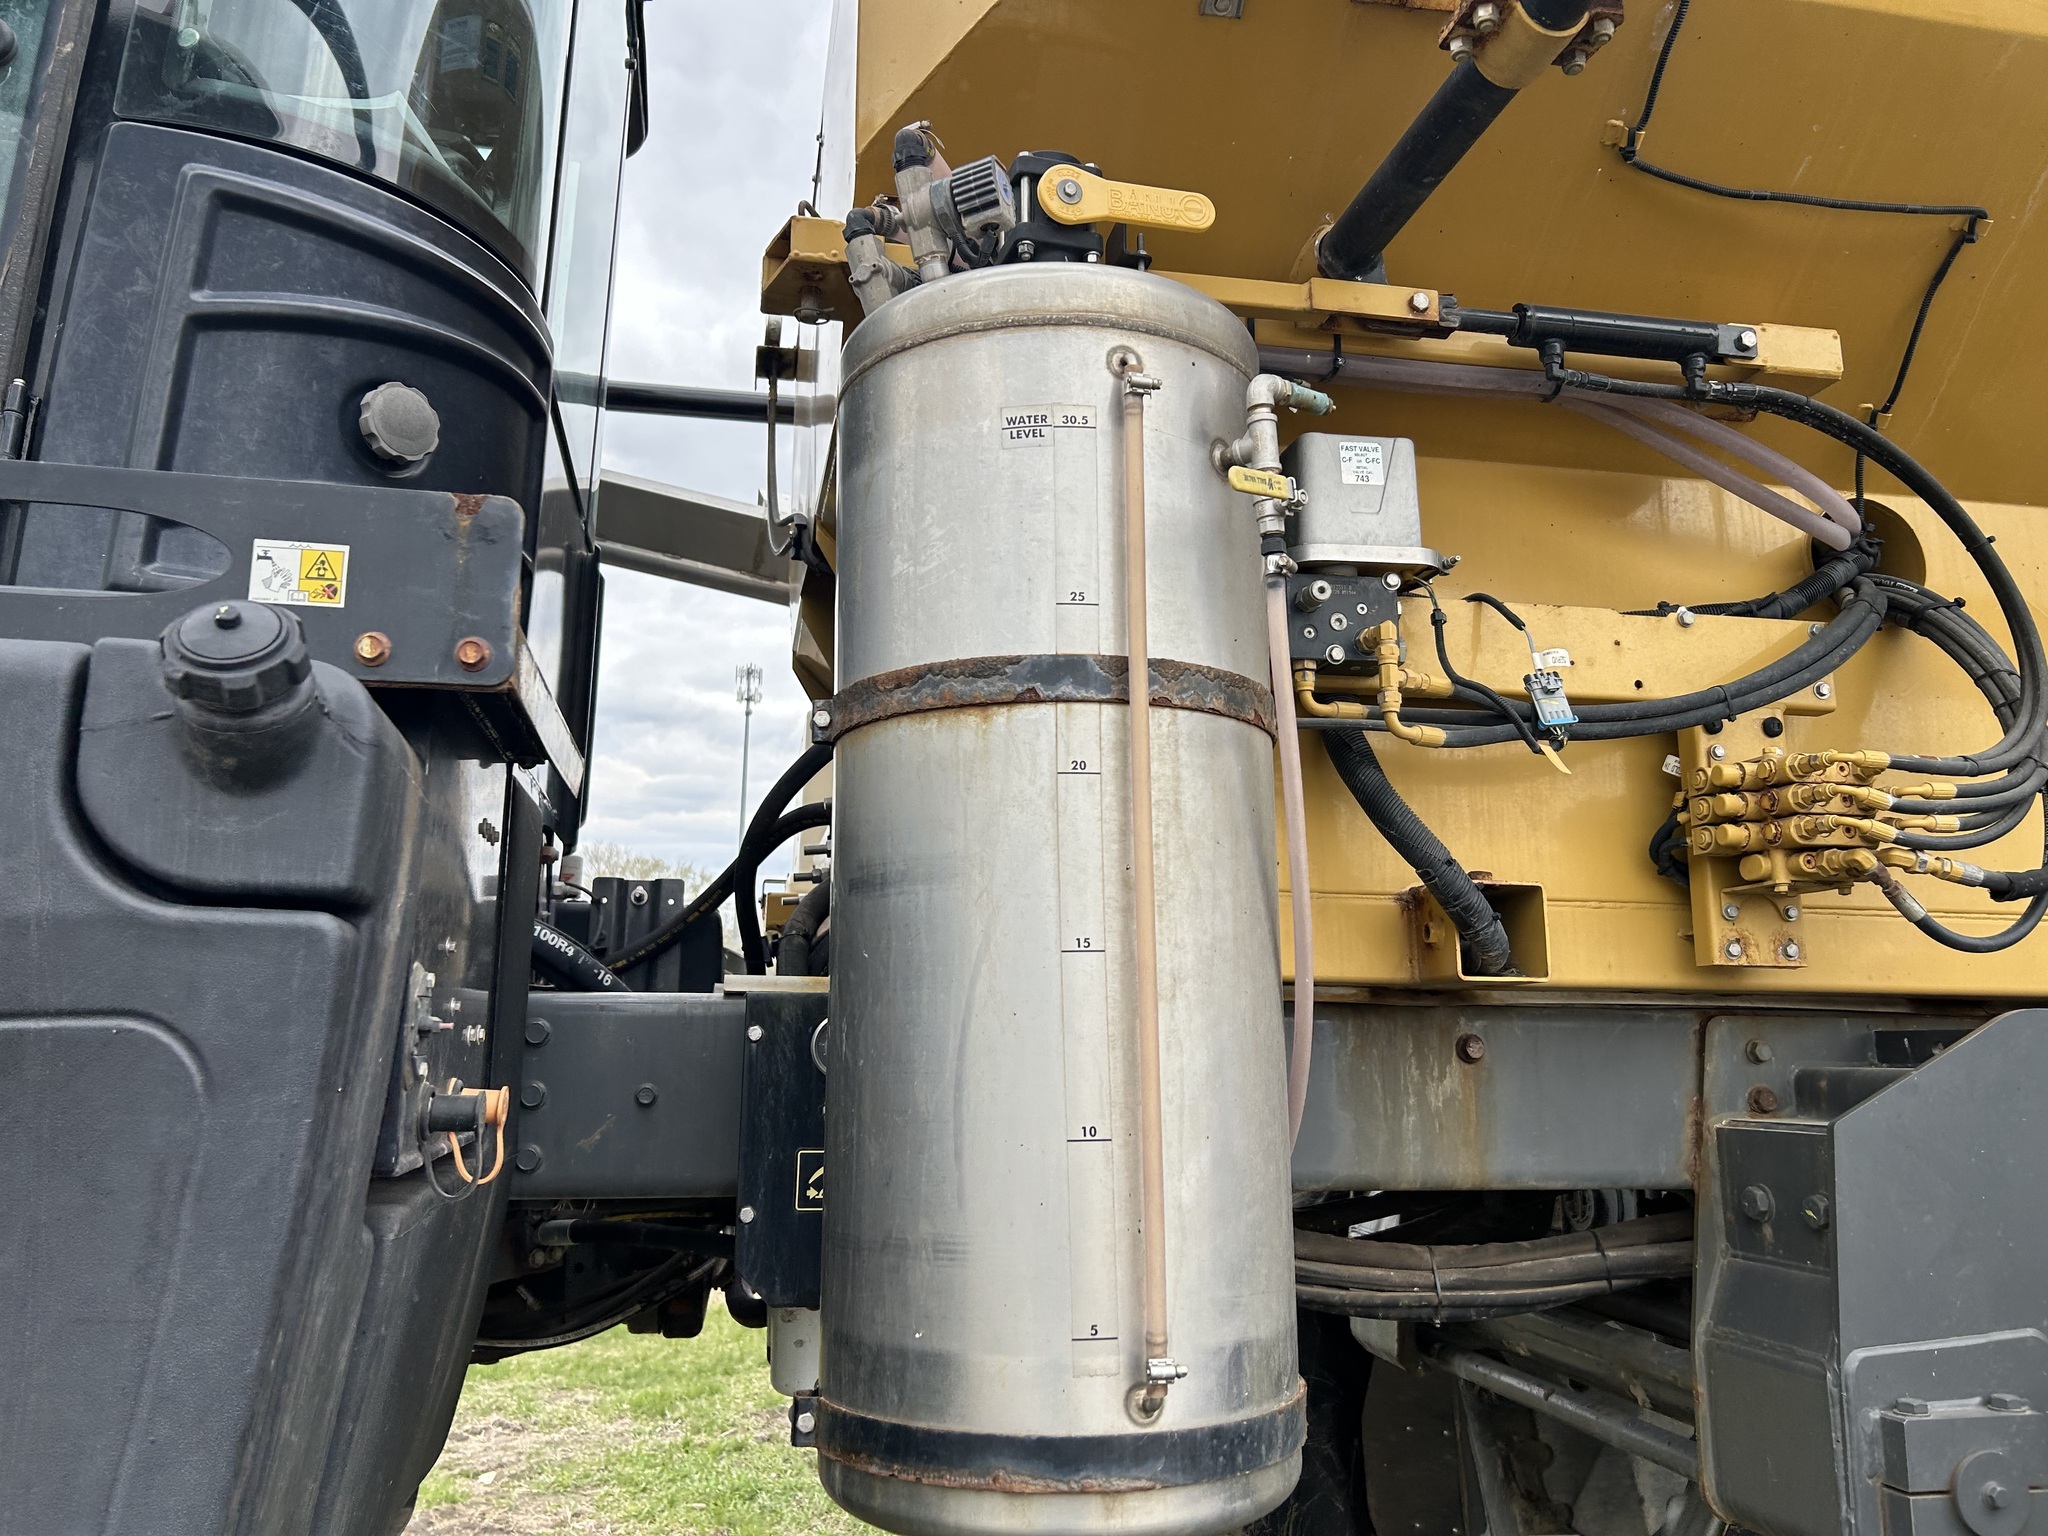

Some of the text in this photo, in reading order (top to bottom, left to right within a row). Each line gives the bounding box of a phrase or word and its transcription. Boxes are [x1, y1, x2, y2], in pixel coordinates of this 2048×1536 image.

[1005, 414, 1048, 426] WATER
[1061, 415, 1089, 425] 30.5
[1009, 428, 1045, 440] LEVEL
[1355, 475, 1370, 483] 743
[1070, 591, 1085, 602] 25
[1071, 760, 1087, 771] 20
[533, 925, 575, 957] 100R4
[1075, 937, 1091, 949] 15
[1081, 1126, 1097, 1138] 10
[1090, 1324, 1099, 1337] 5
